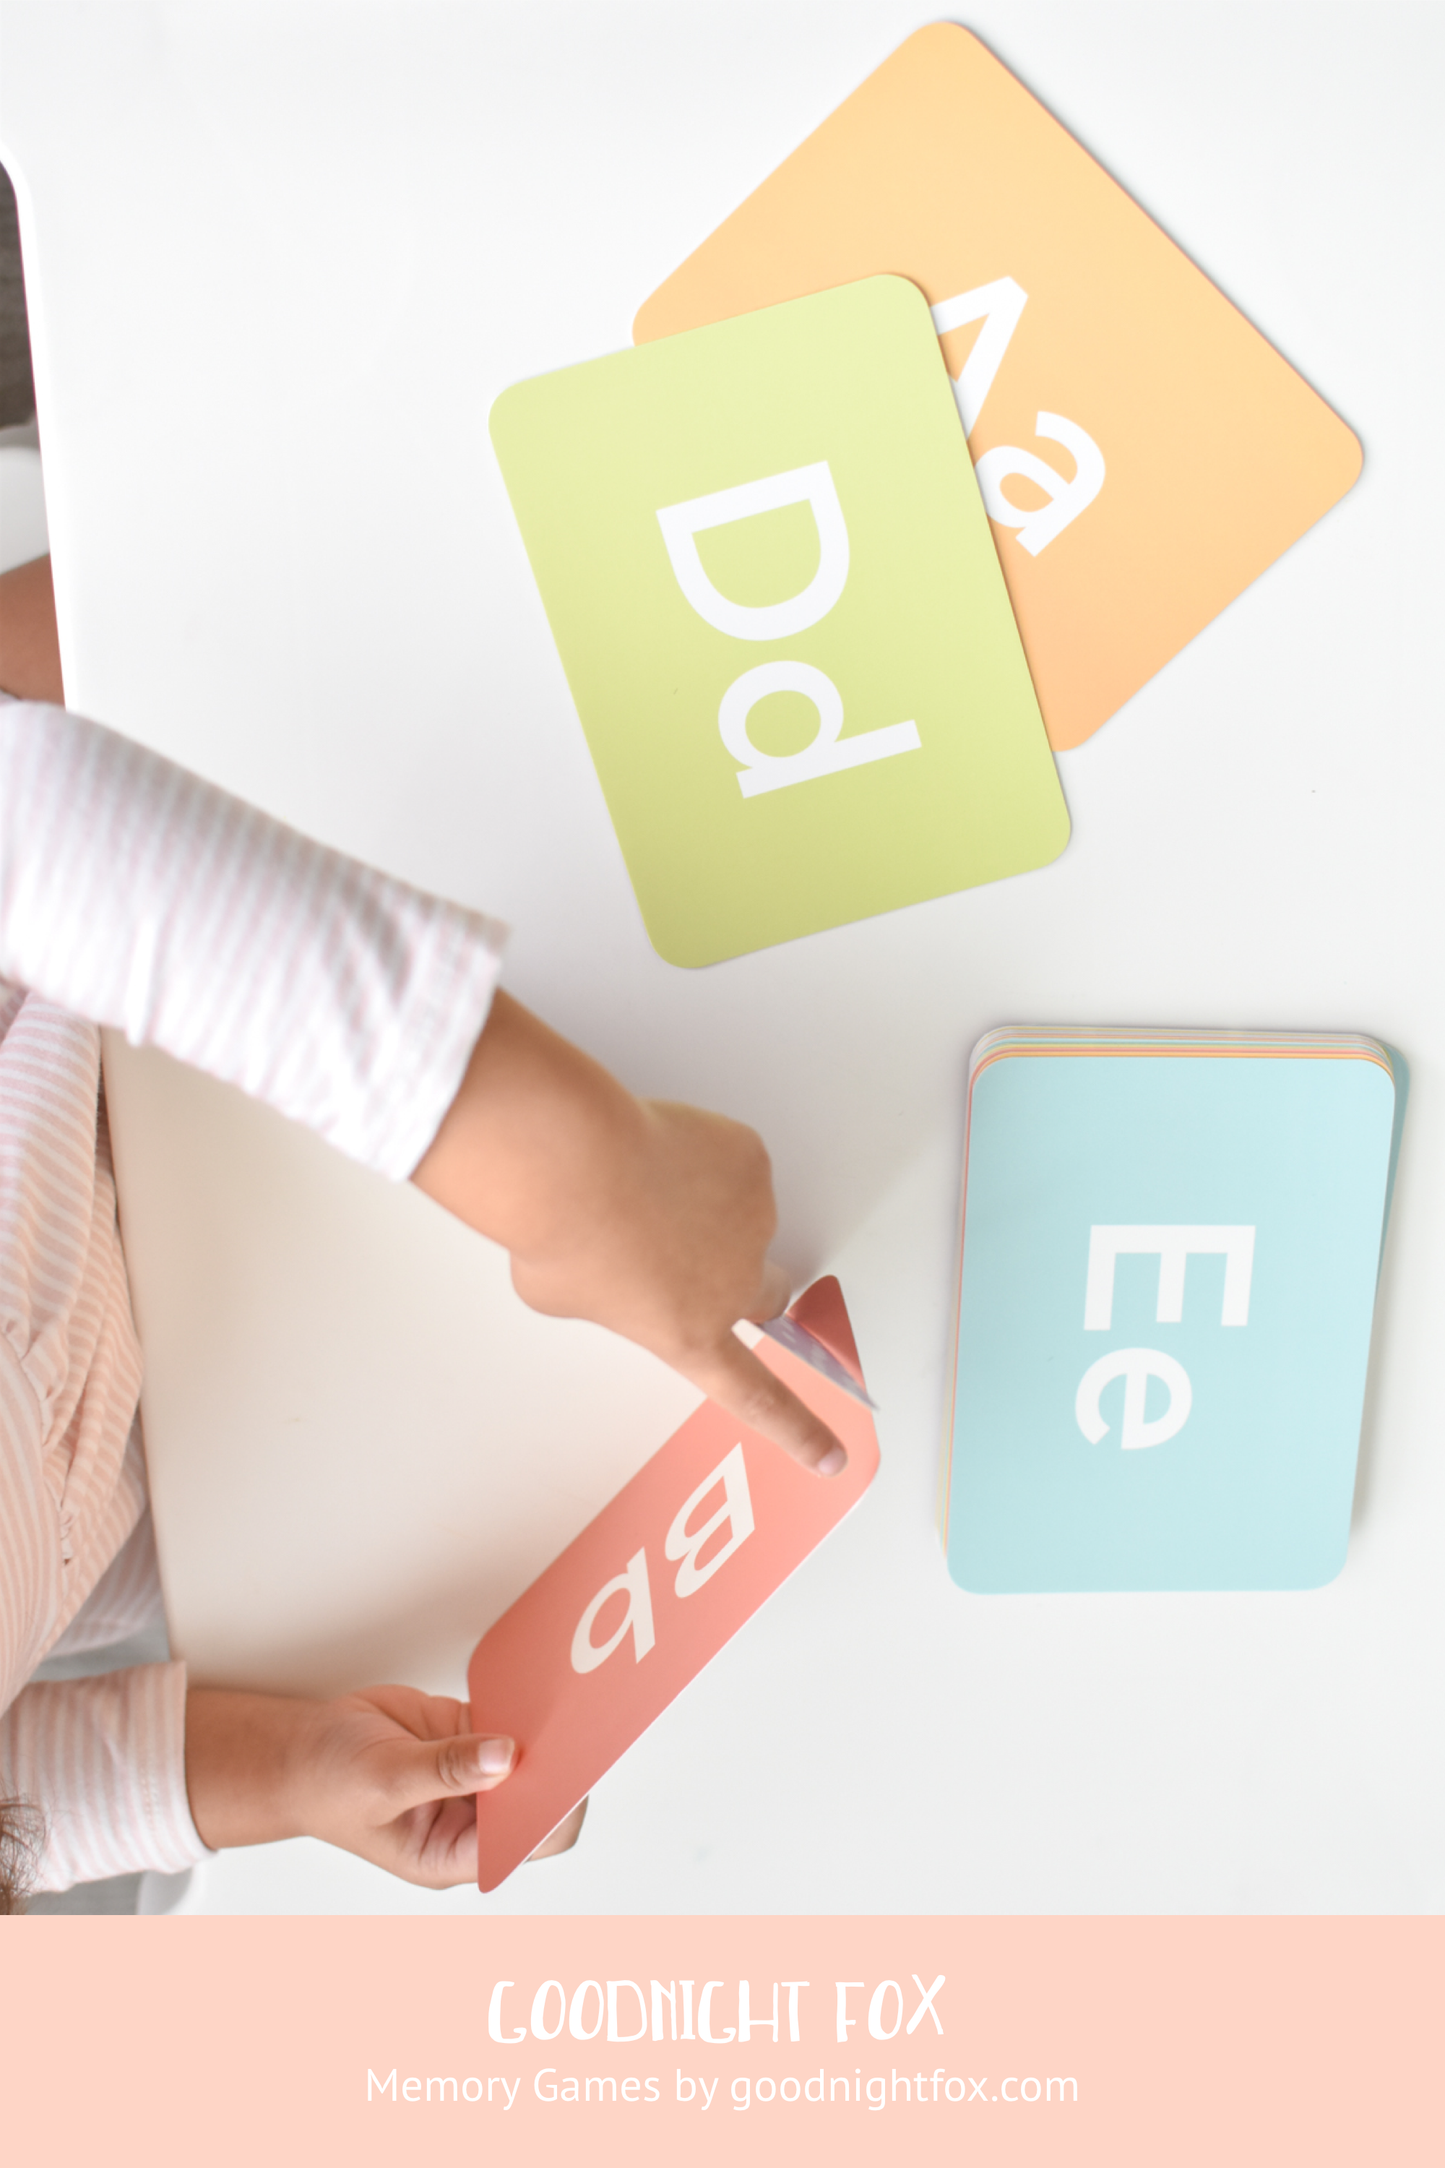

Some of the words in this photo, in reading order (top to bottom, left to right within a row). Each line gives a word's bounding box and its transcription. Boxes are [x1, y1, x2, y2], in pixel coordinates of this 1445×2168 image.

[931, 276, 1106, 557] Aa
[655, 460, 922, 799] Dd
[1075, 1224, 1256, 1451] Ee
[571, 1441, 756, 1674] Bb
